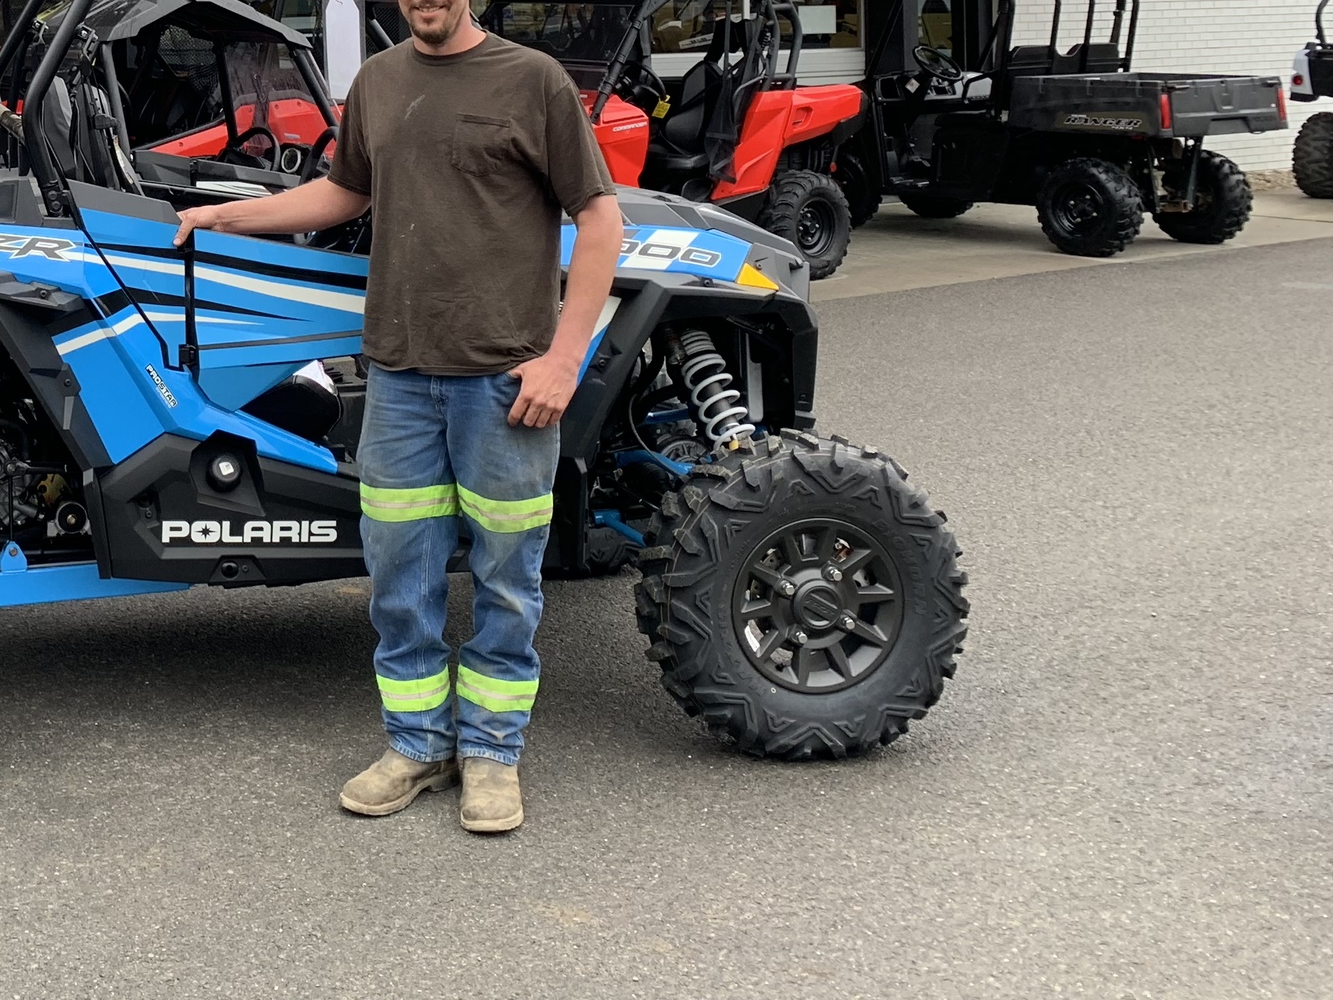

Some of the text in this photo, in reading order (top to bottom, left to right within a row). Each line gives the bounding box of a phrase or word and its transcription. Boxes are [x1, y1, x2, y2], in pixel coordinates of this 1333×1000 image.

[1063, 115, 1142, 127] RANGER
[145, 364, 178, 408] PROSTAR
[161, 520, 338, 543] POLARIS
